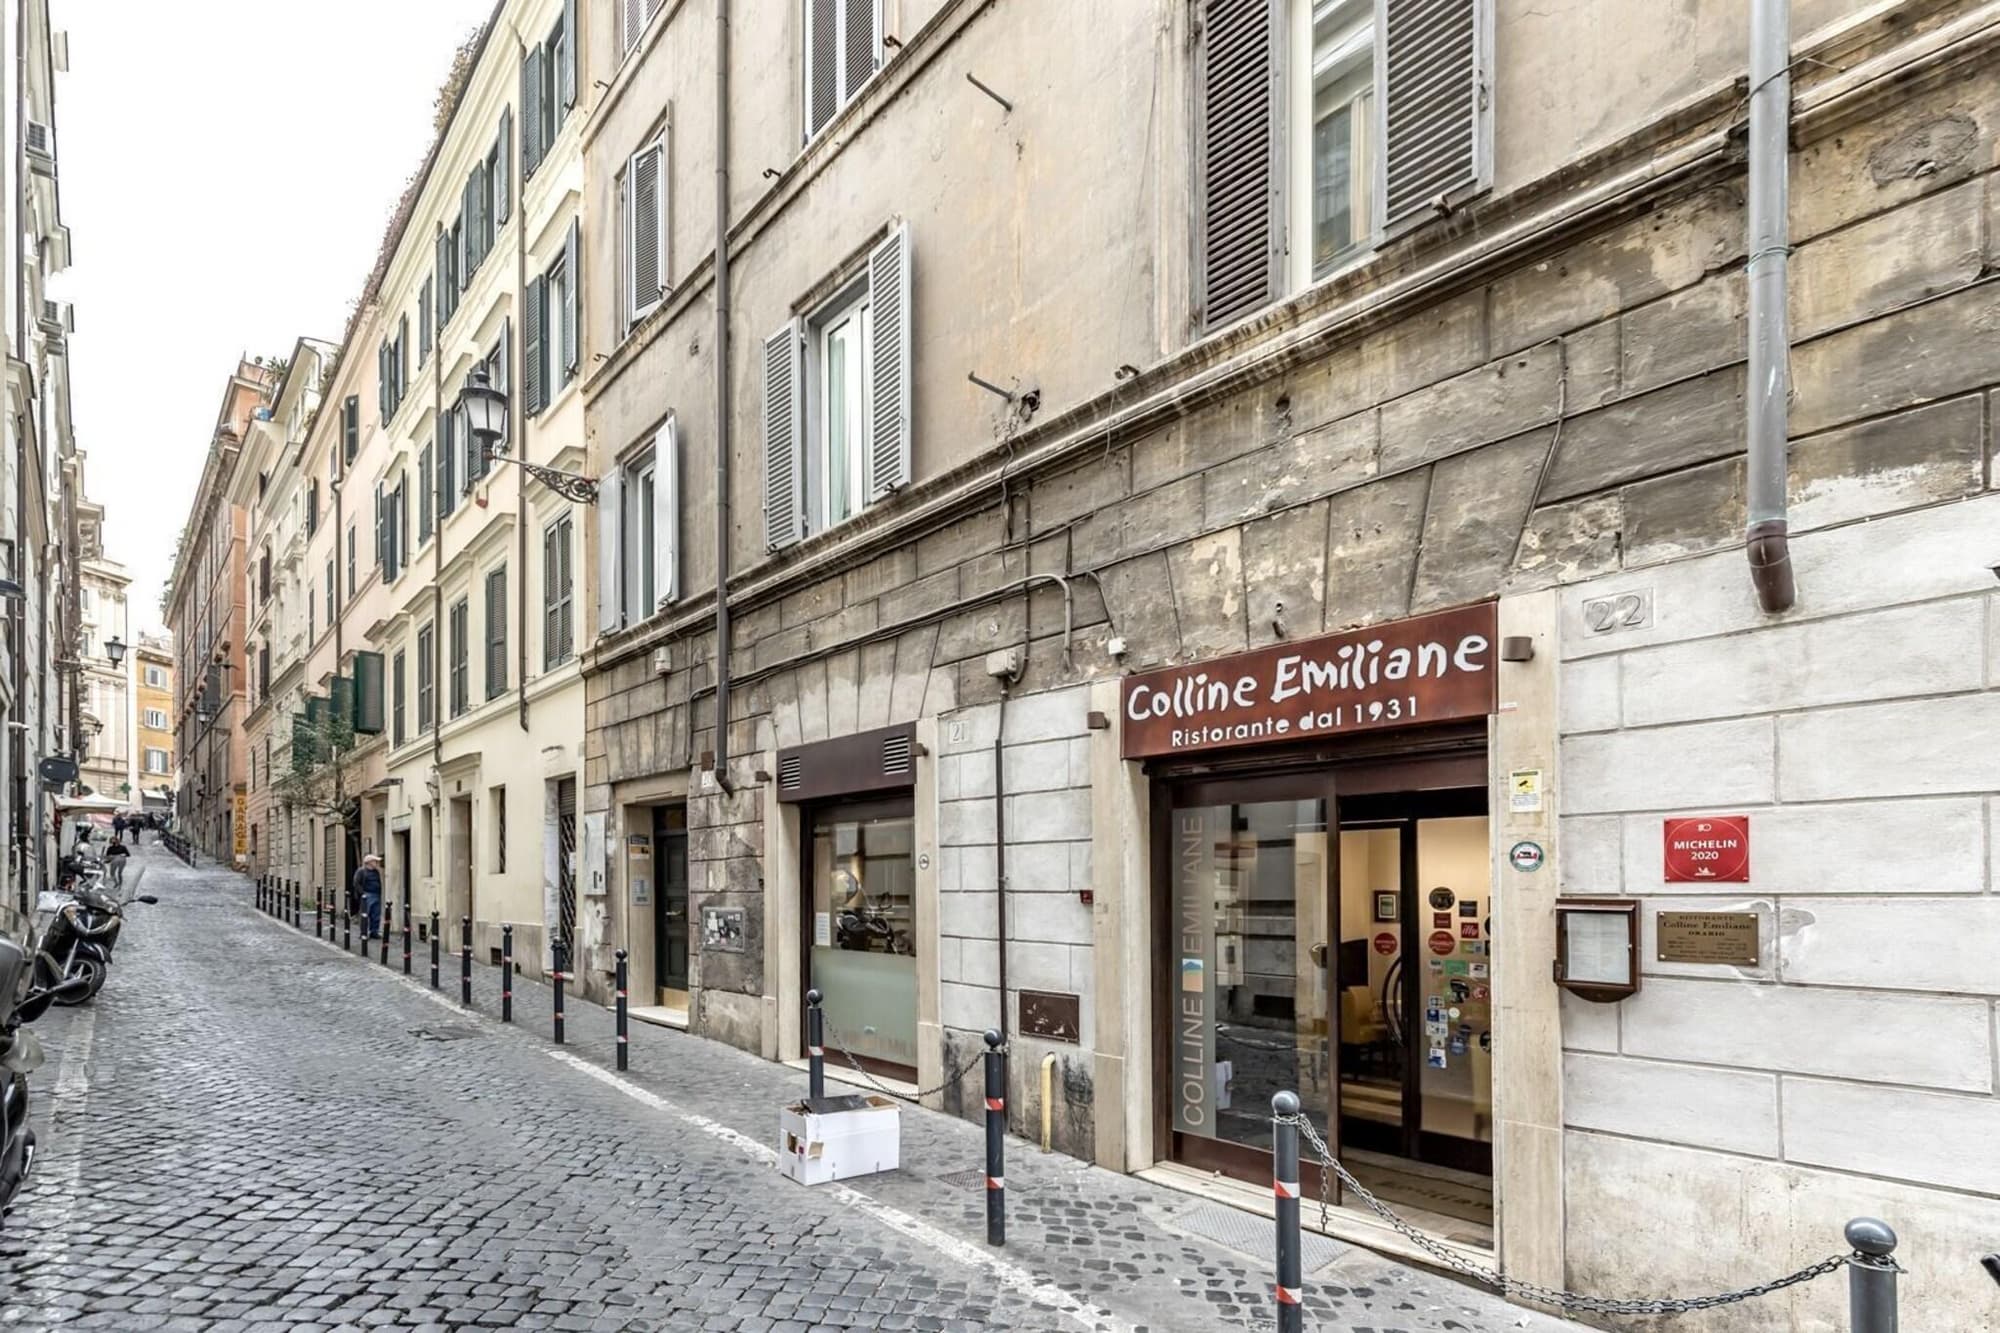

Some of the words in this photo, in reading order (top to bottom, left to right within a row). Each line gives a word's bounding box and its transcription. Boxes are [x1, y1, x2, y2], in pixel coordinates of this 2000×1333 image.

[1590, 594, 1646, 632] 22
[1128, 673, 1258, 721] Colline
[1270, 634, 1489, 704] Emiliane
[1172, 718, 1290, 747] Ristorante
[1299, 708, 1342, 731] dal
[1355, 696, 1418, 723] 1931
[1674, 840, 1737, 850] MICHELIN
[1691, 851, 1719, 861] 2020
[1182, 815, 1203, 954] EMILIANE
[1663, 921, 1698, 929] Colline
[1703, 921, 1752, 930] Emiliane
[1182, 999, 1205, 1126] COLLINE
